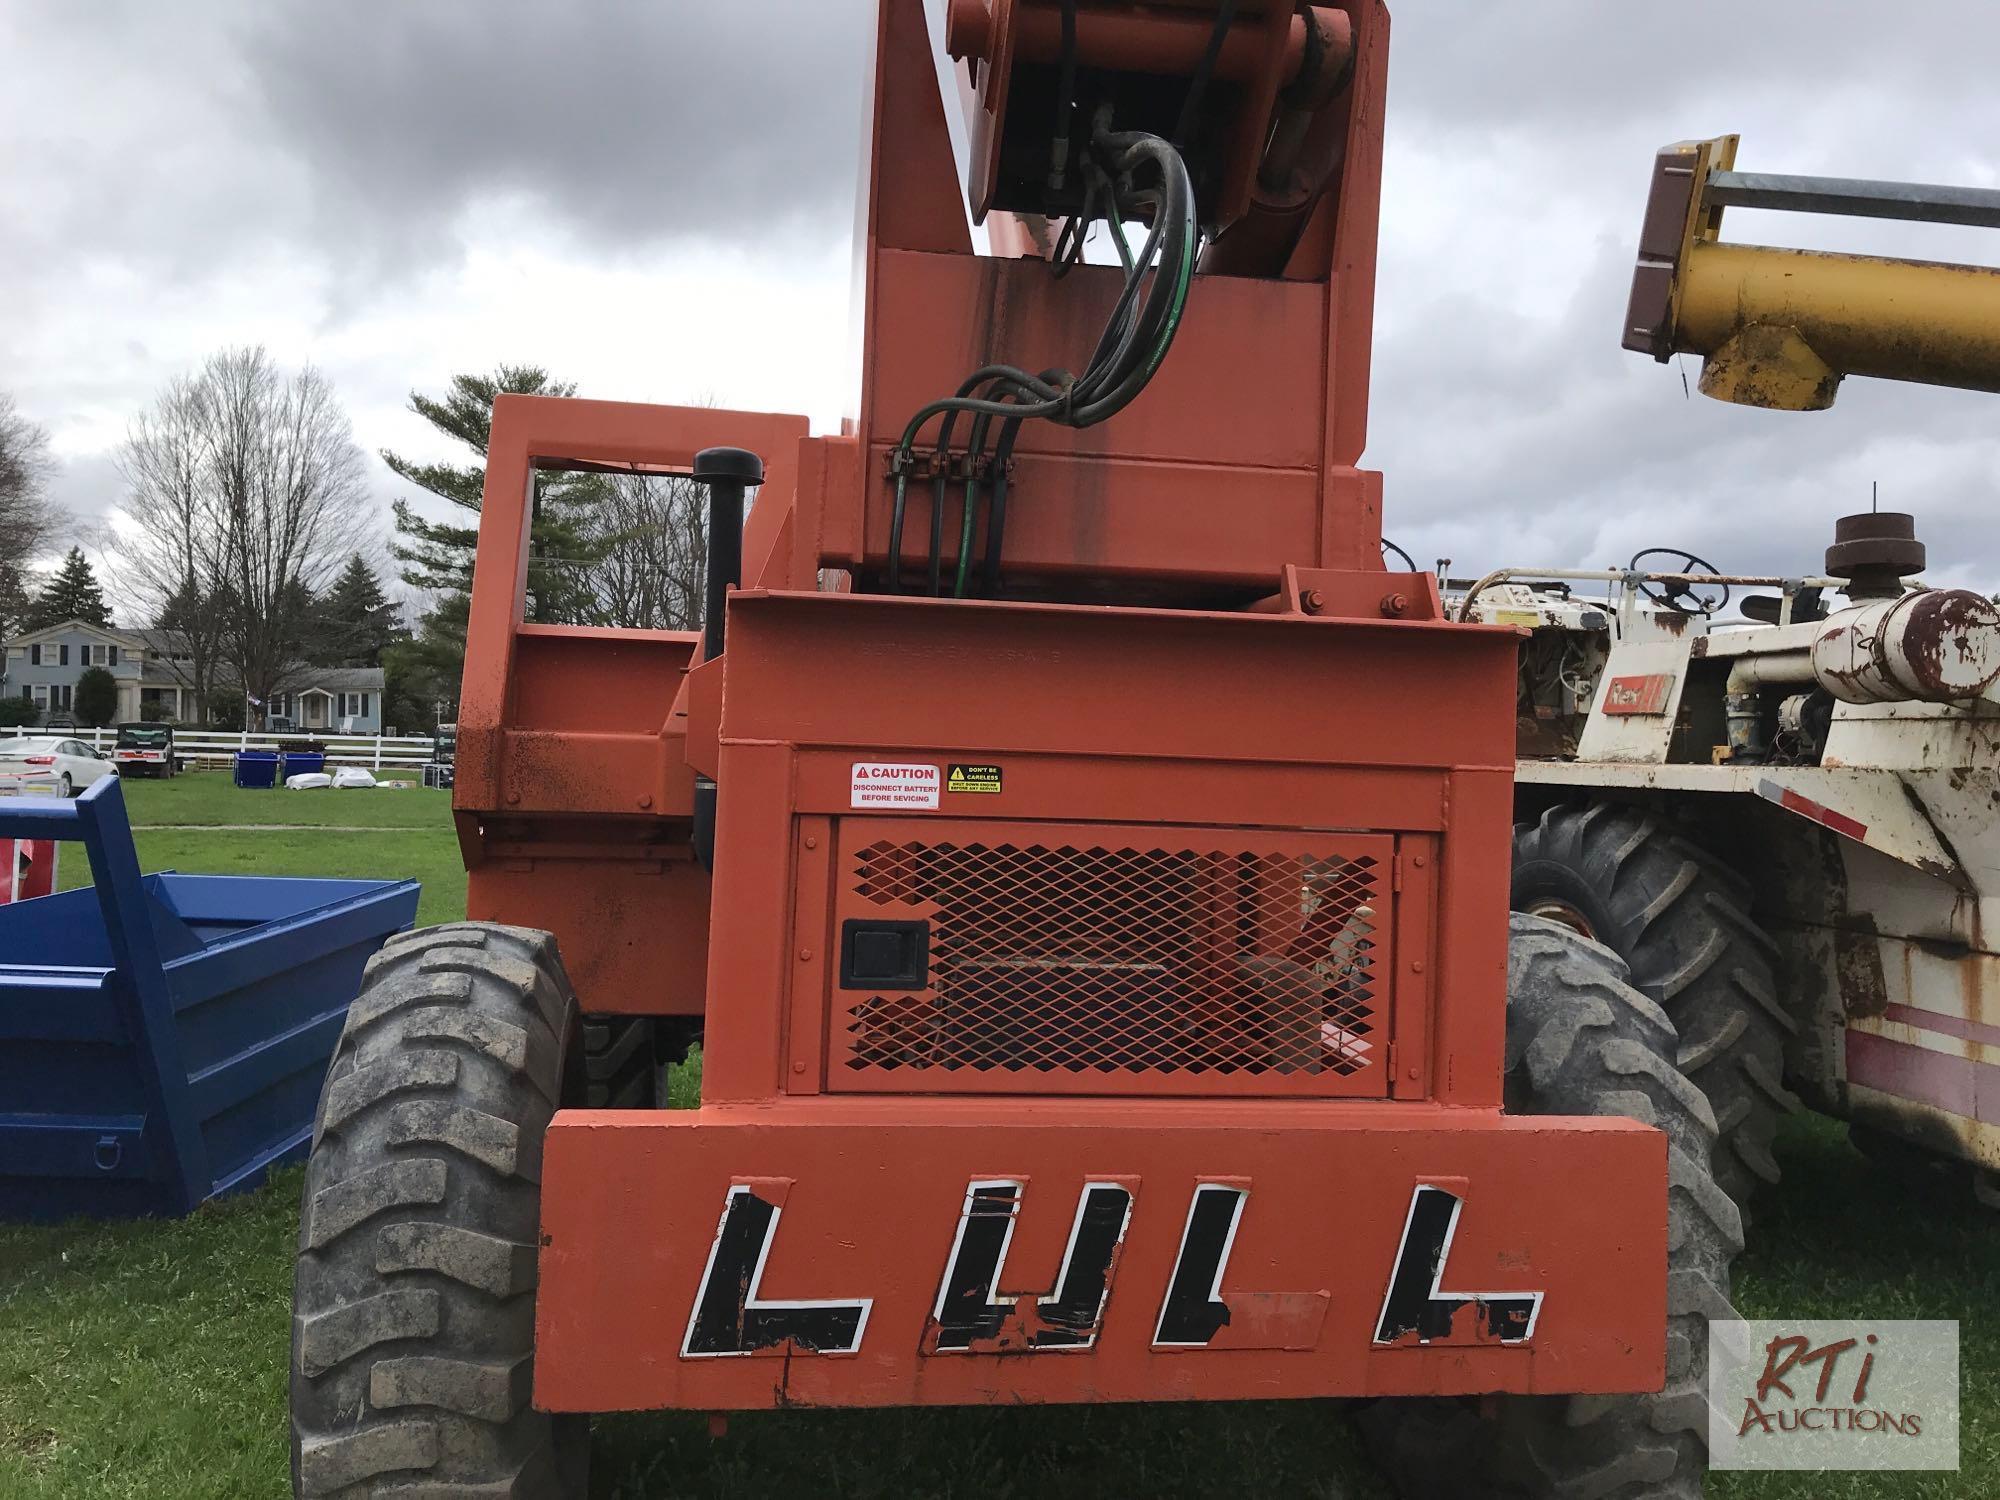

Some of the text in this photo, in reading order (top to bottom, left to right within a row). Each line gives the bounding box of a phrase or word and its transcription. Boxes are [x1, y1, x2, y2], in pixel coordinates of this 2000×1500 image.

[871, 767, 935, 780] CAUTION
[853, 784, 903, 792] DISCONNECT
[893, 795, 930, 803] SEVICING
[680, 1178, 1545, 1359] LULL
